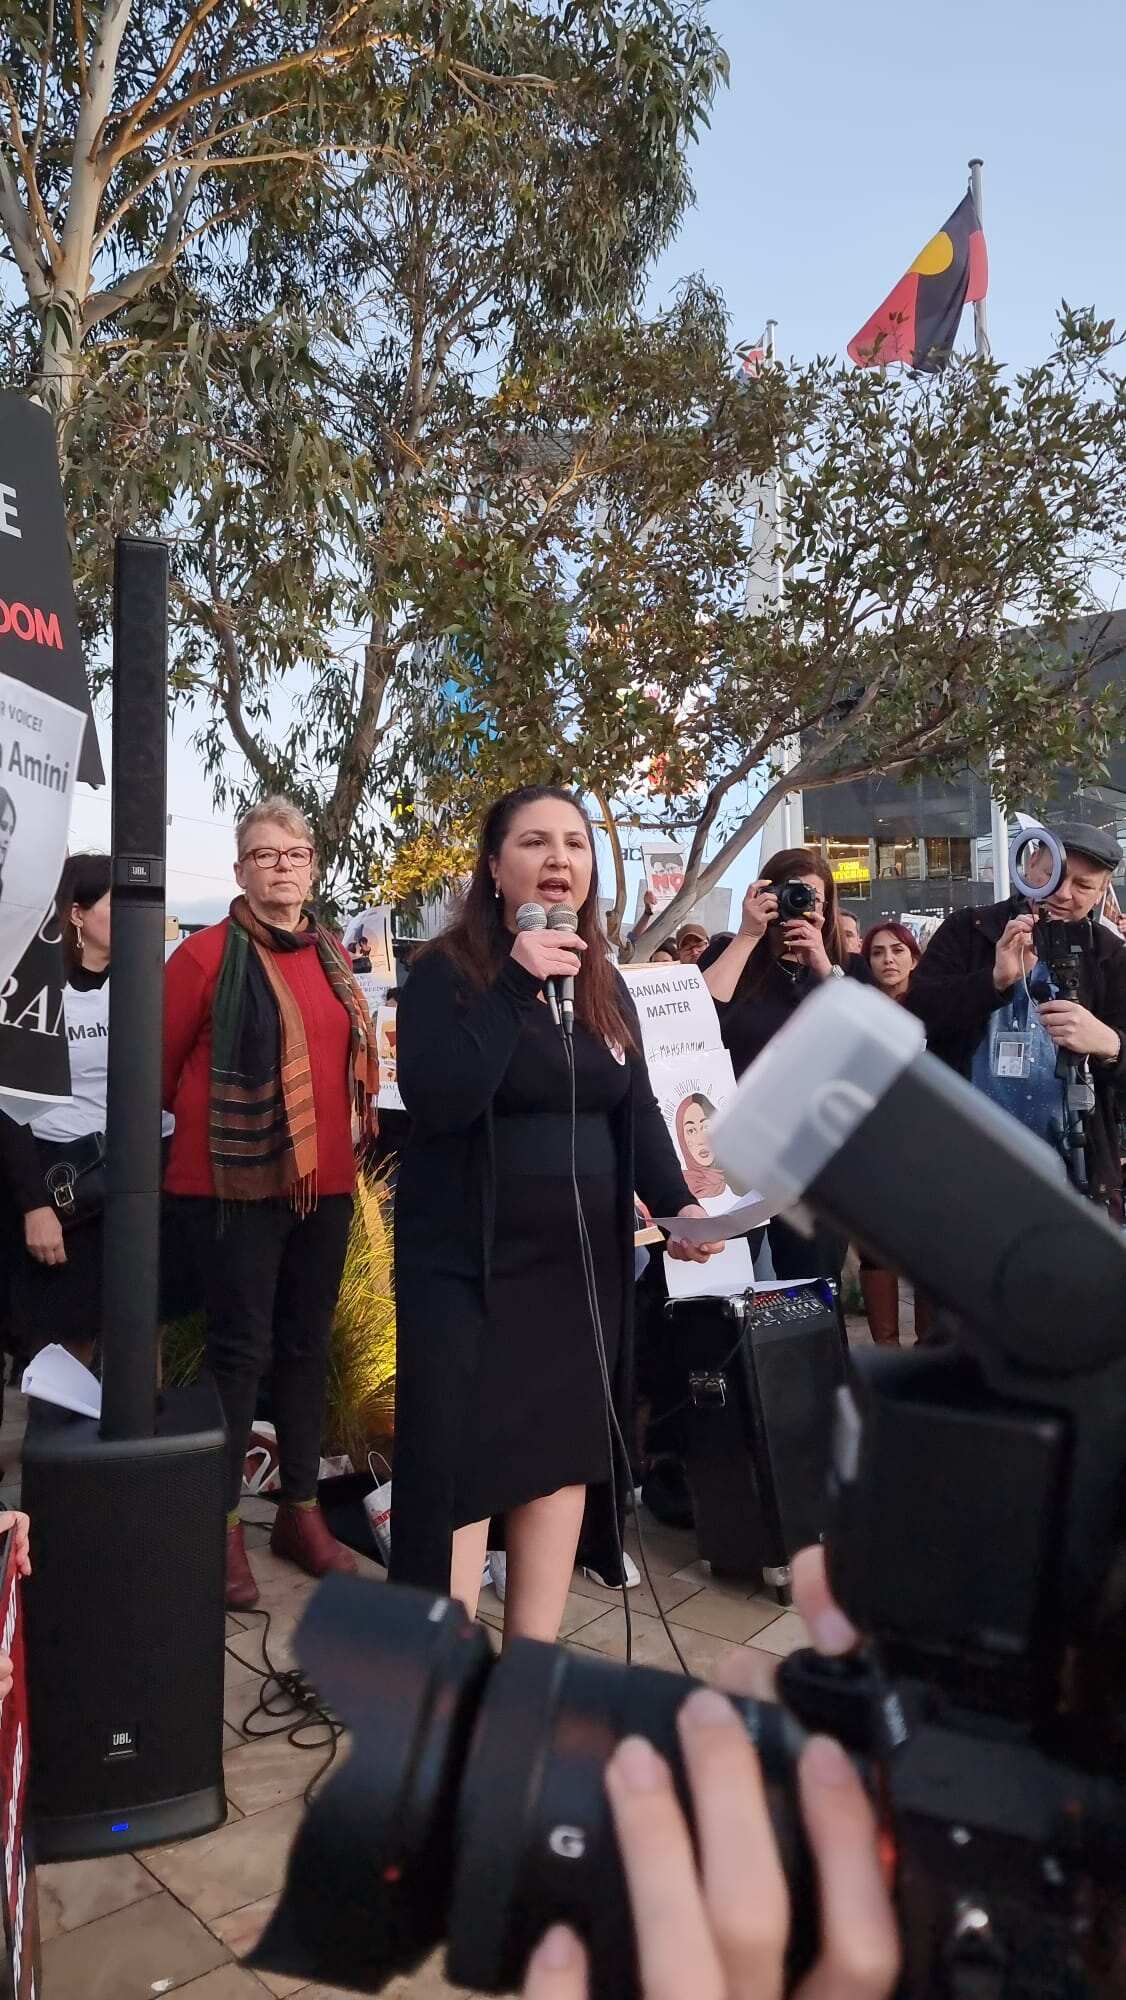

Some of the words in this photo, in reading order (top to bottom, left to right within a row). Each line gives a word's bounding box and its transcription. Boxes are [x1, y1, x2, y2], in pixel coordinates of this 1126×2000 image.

[8, 704, 44, 732] VOICE!
[8, 740, 70, 793] Amini
[672, 978, 700, 992] LIVES
[646, 1001, 691, 1018] MATTER
[112, 1732, 132, 1746] JBL
[549, 1825, 585, 1858] G
